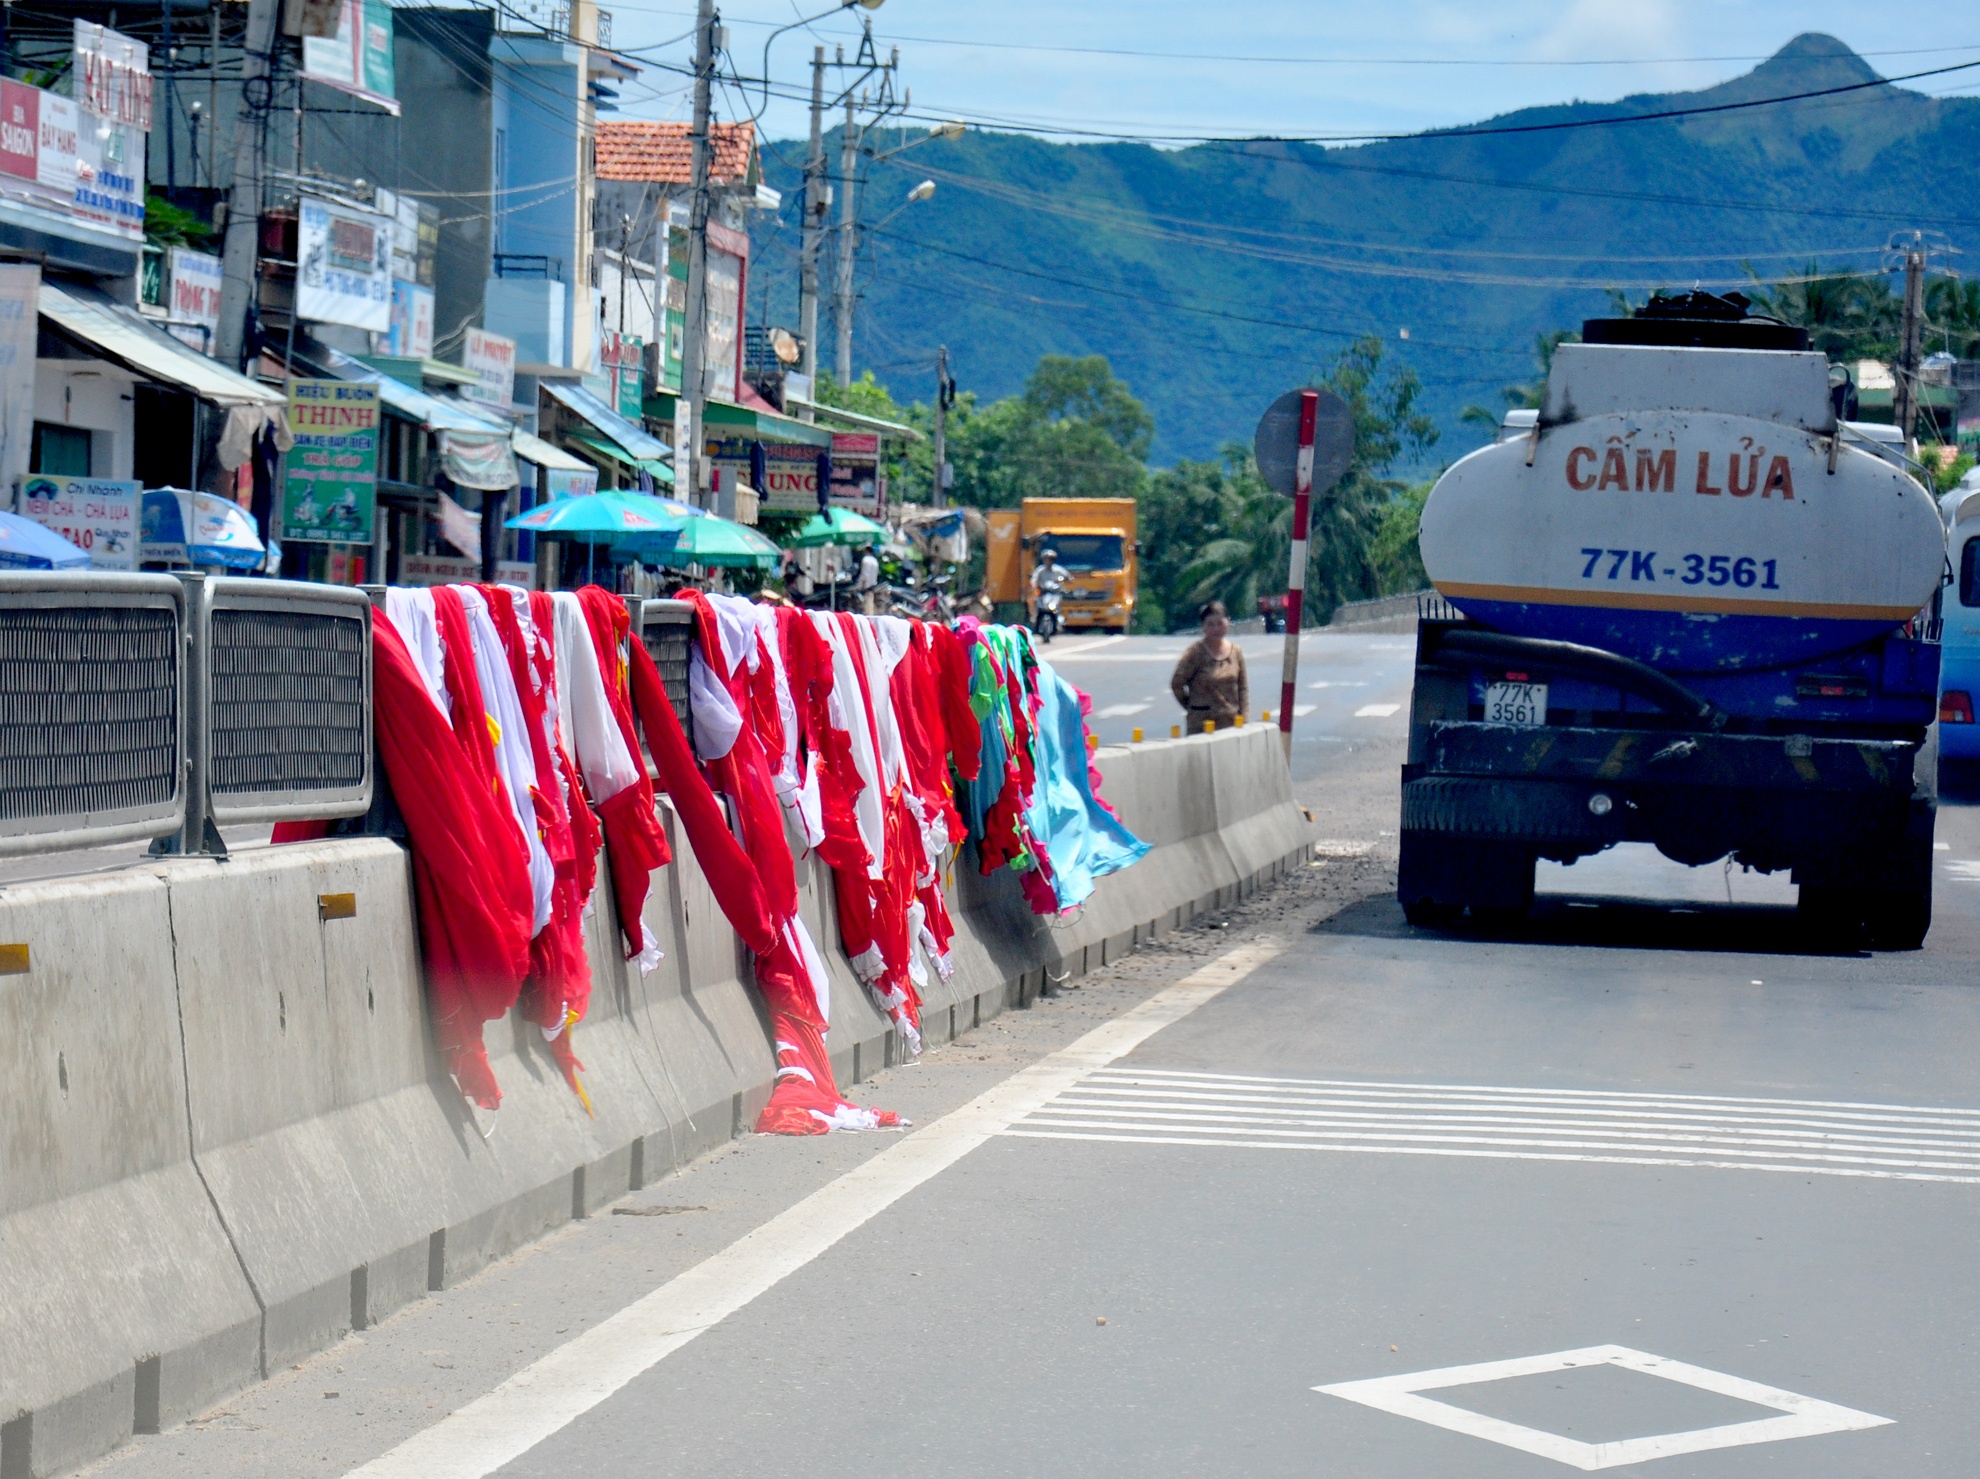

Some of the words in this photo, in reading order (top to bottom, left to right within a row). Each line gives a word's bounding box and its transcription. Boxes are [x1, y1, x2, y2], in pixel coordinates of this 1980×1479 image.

[294, 404, 374, 431] THỊNH
[1565, 431, 1677, 493] CẤM
[1695, 436, 1795, 500] LỬA
[1580, 548, 1779, 590] 77K-3561
[1500, 683, 1534, 703] 77K
[1492, 703, 1535, 724] 3561
